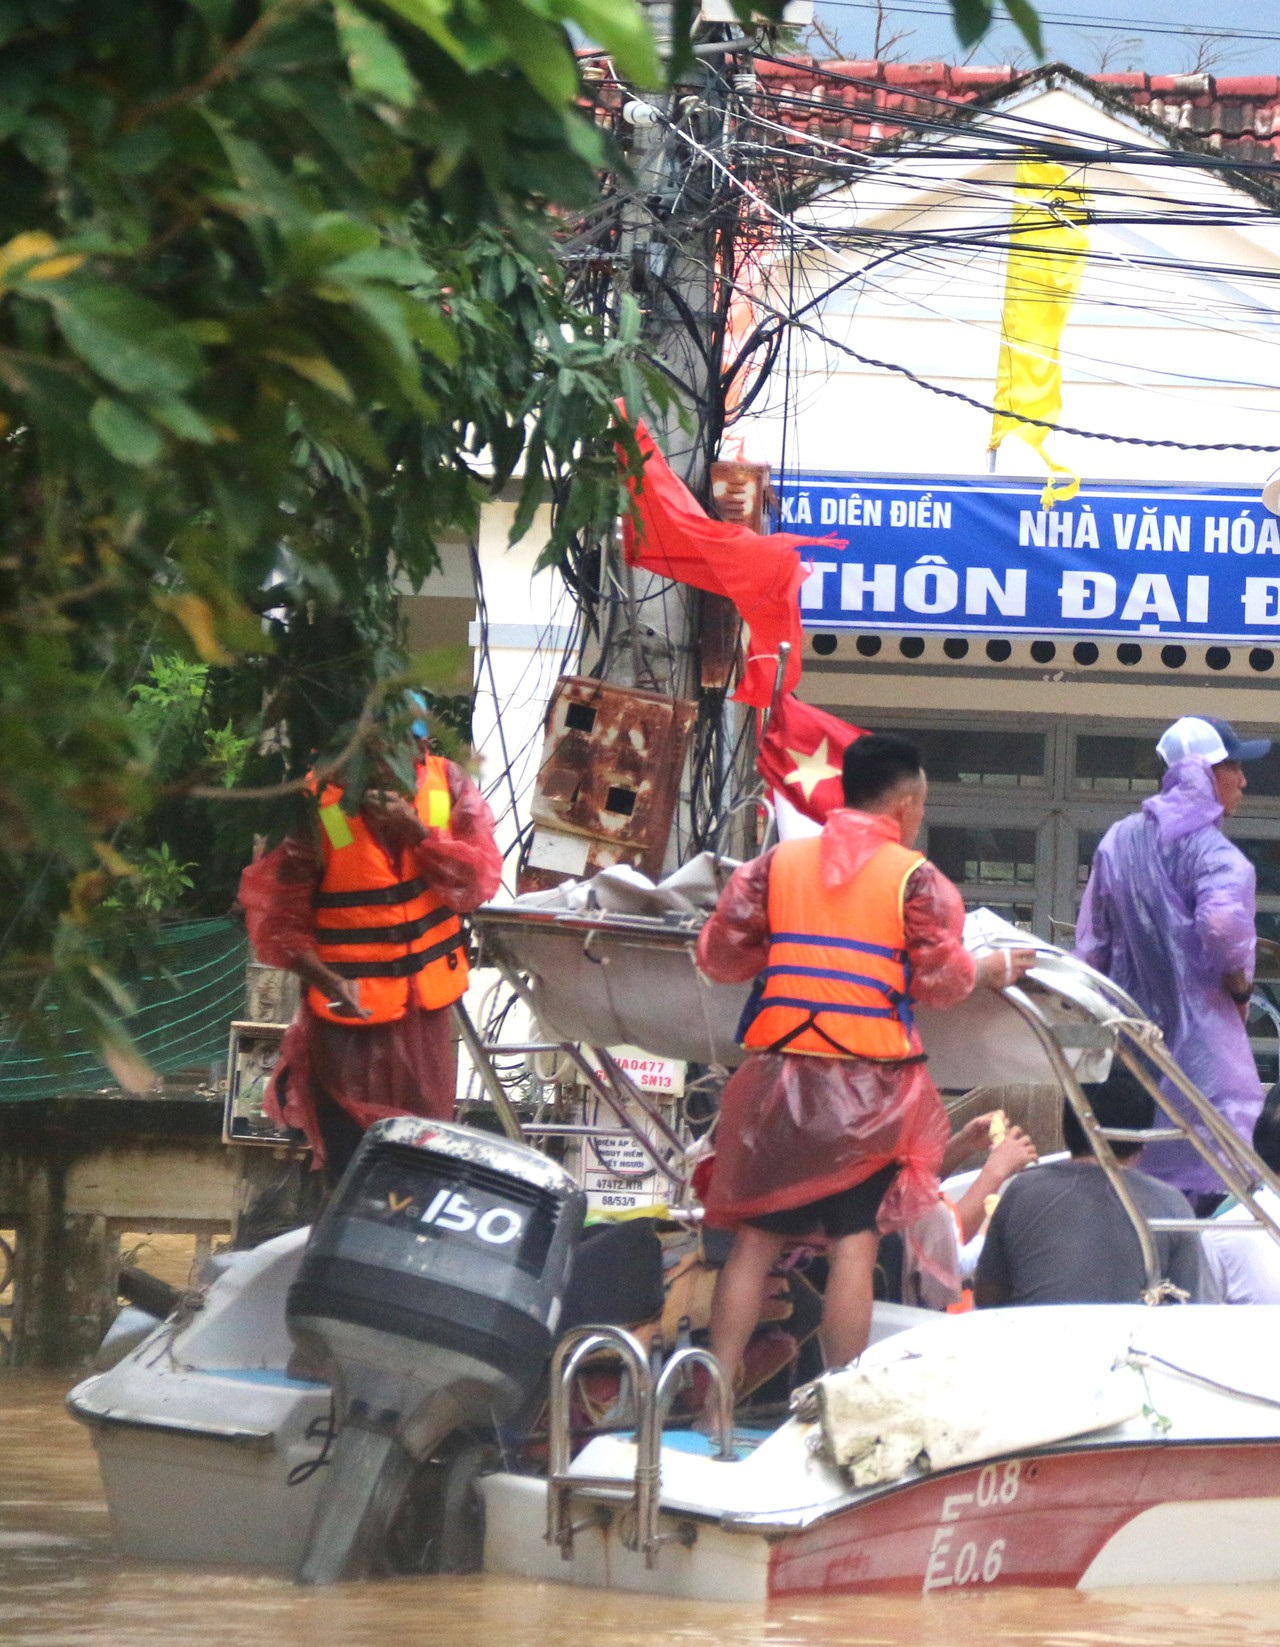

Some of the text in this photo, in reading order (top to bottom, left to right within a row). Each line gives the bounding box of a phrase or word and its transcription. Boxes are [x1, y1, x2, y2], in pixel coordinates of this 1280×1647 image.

[780, 492, 952, 529] XÃ DIÊN ĐIỀN
[1020, 500, 1100, 550] NHÀ
[1114, 506, 1190, 553] VĂN
[800, 554, 1028, 616] THÔN
[1058, 570, 1210, 634] ĐẠI
[641, 1074, 672, 1087] SN13
[420, 1189, 522, 1244] 150
[975, 1459, 1021, 1507] 0.8
[954, 1538, 1006, 1586] 0.6
